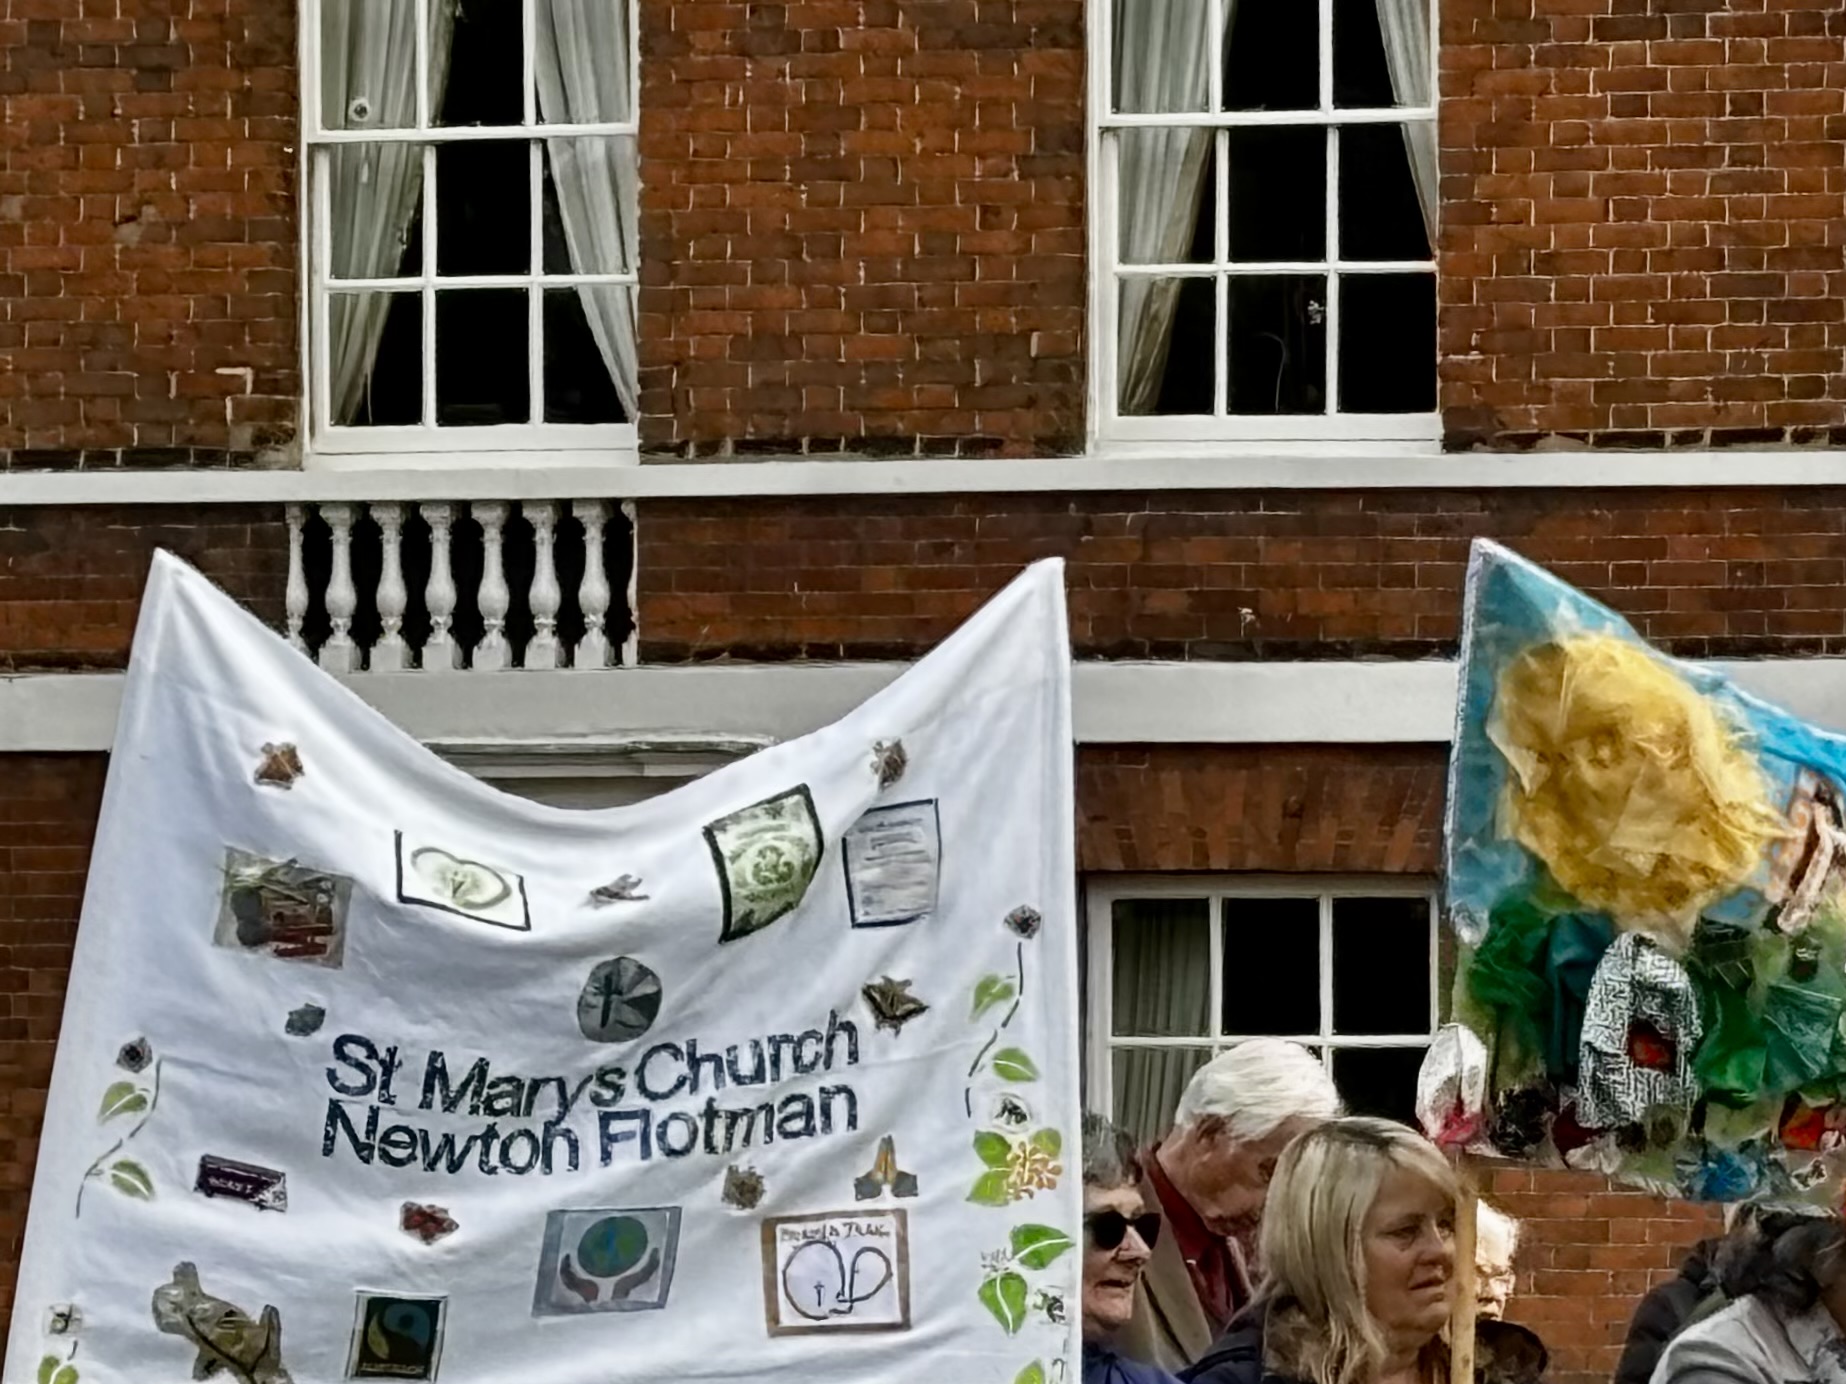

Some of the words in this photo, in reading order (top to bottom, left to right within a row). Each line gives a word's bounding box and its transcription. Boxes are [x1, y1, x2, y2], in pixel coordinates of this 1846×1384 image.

[326, 1033, 402, 1104] St
[634, 1008, 860, 1100] Church
[322, 1098, 581, 1175] Newton
[598, 1082, 859, 1168] Flotman
